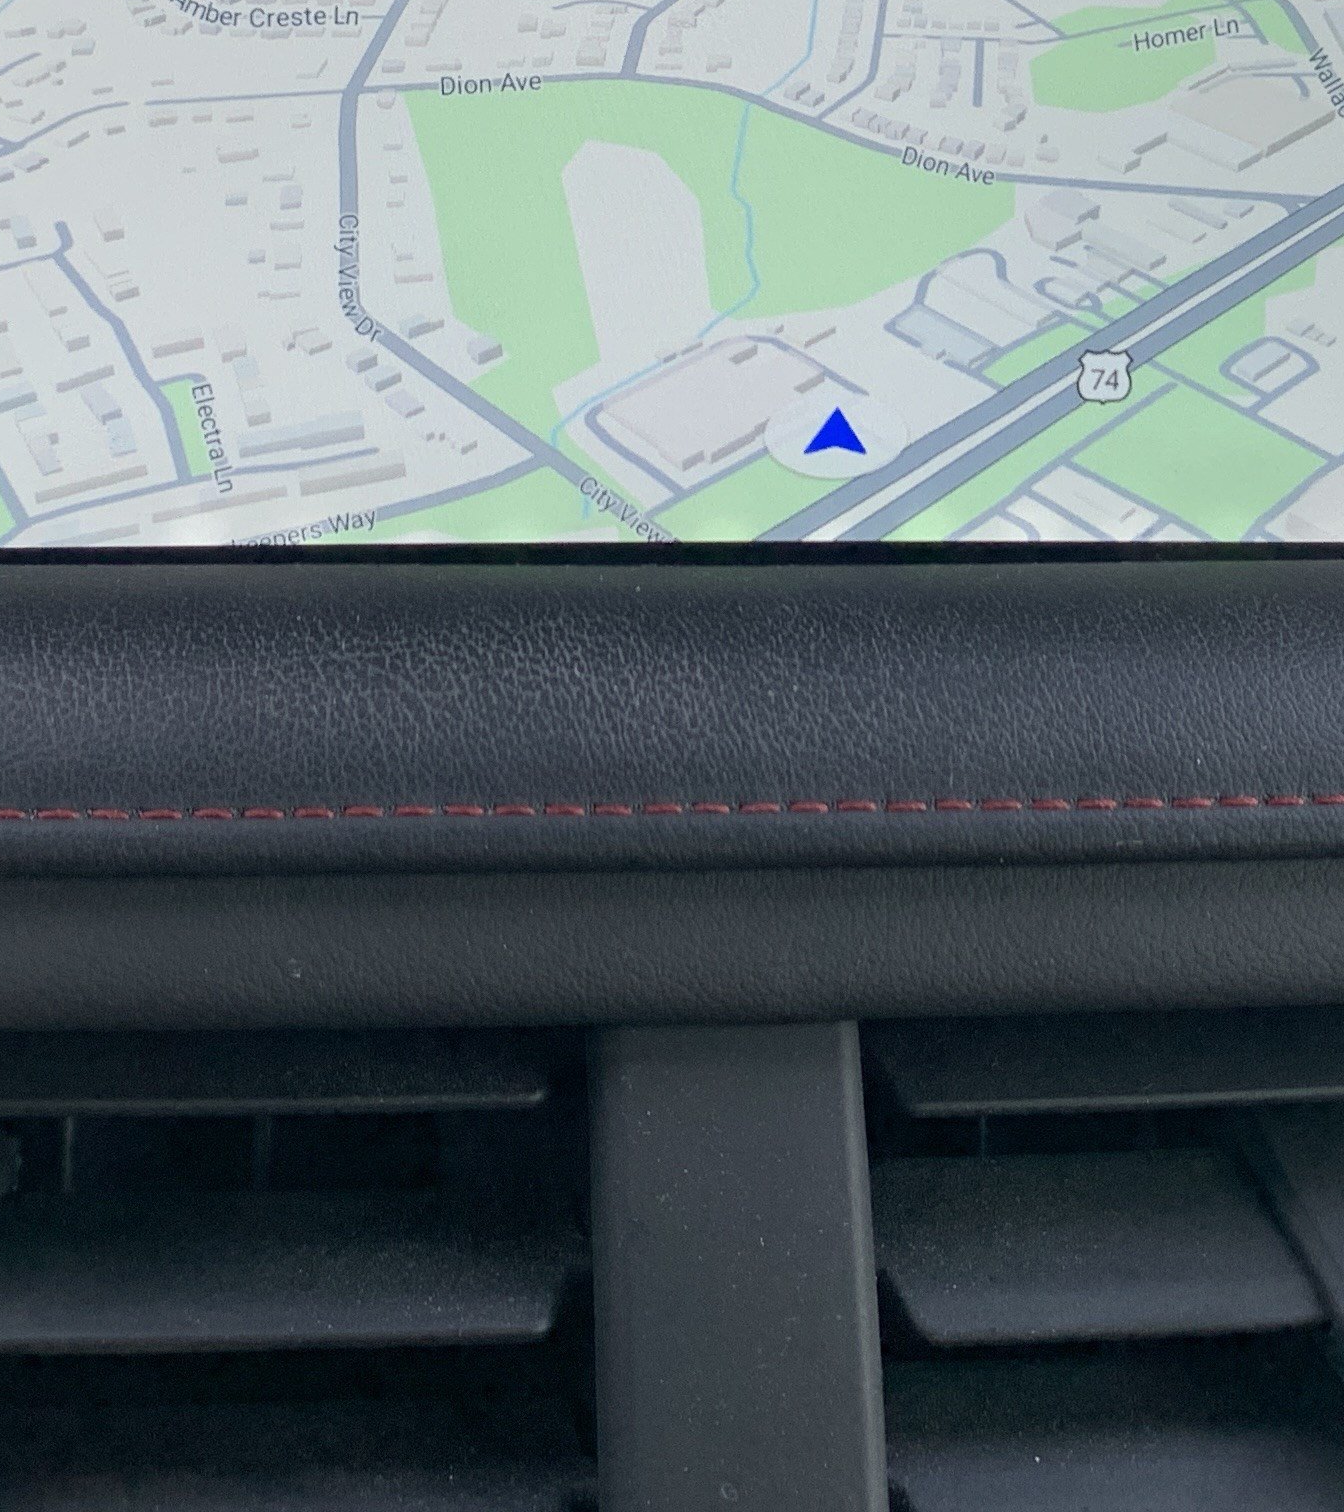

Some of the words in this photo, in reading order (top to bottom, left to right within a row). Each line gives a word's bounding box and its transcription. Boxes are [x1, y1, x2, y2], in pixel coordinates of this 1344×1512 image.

[249, 6, 328, 28] Creste
[333, 5, 360, 26] Ln
[1133, 22, 1207, 52] Homer
[1212, 17, 1240, 37] Ln
[440, 75, 492, 96] Dion
[500, 73, 543, 93] Ave
[900, 145, 951, 177] Dion
[954, 162, 996, 186] Ave
[333, 214, 360, 257] City
[337, 264, 364, 320] View
[354, 315, 383, 343] Dr
[1089, 368, 1121, 391] 74
[191, 383, 226, 462] Electra
[213, 464, 234, 494] Ln
[580, 477, 617, 513] City
[327, 510, 376, 534] Way
